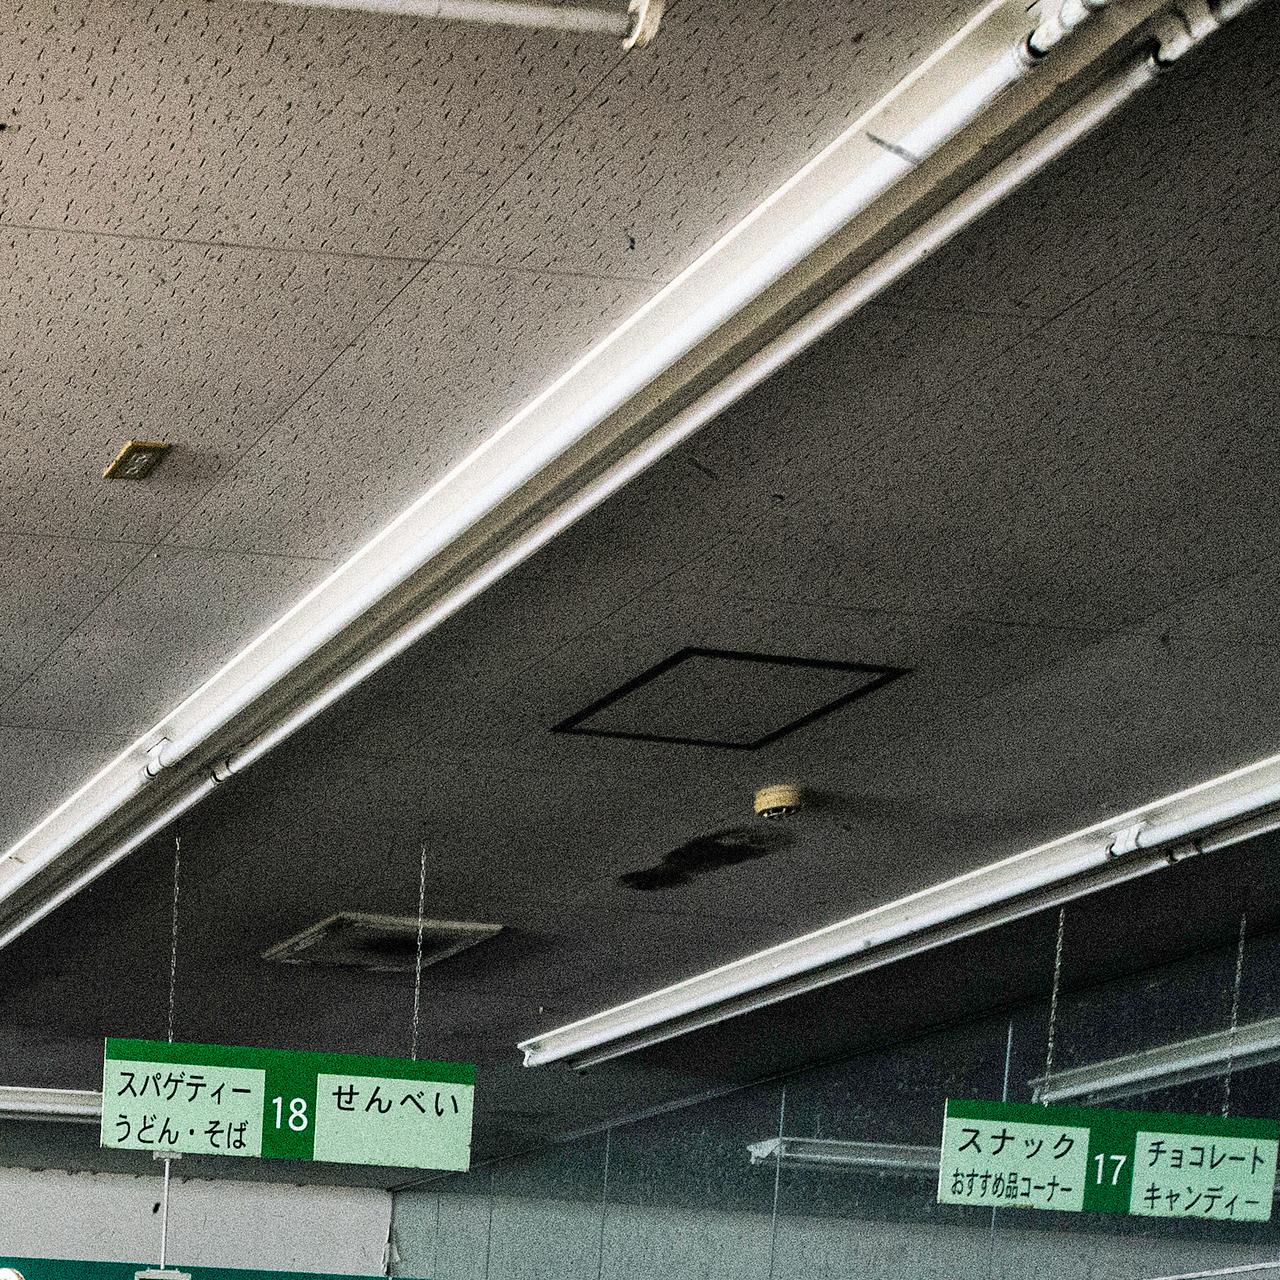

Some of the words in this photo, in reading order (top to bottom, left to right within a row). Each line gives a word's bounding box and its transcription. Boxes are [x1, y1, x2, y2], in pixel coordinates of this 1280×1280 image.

[116, 1070, 252, 1106] スパゲティー
[332, 1084, 460, 1118] せんべい
[115, 1113, 250, 1150] うどん・そば
[271, 1095, 309, 1132] 18
[958, 1127, 1076, 1160] スナック
[1147, 1139, 1266, 1175] チョコレート
[950, 1167, 1074, 1203] おすすめ品コーナー
[1093, 1153, 1129, 1187] 17
[1143, 1181, 1261, 1216] キャンディー
